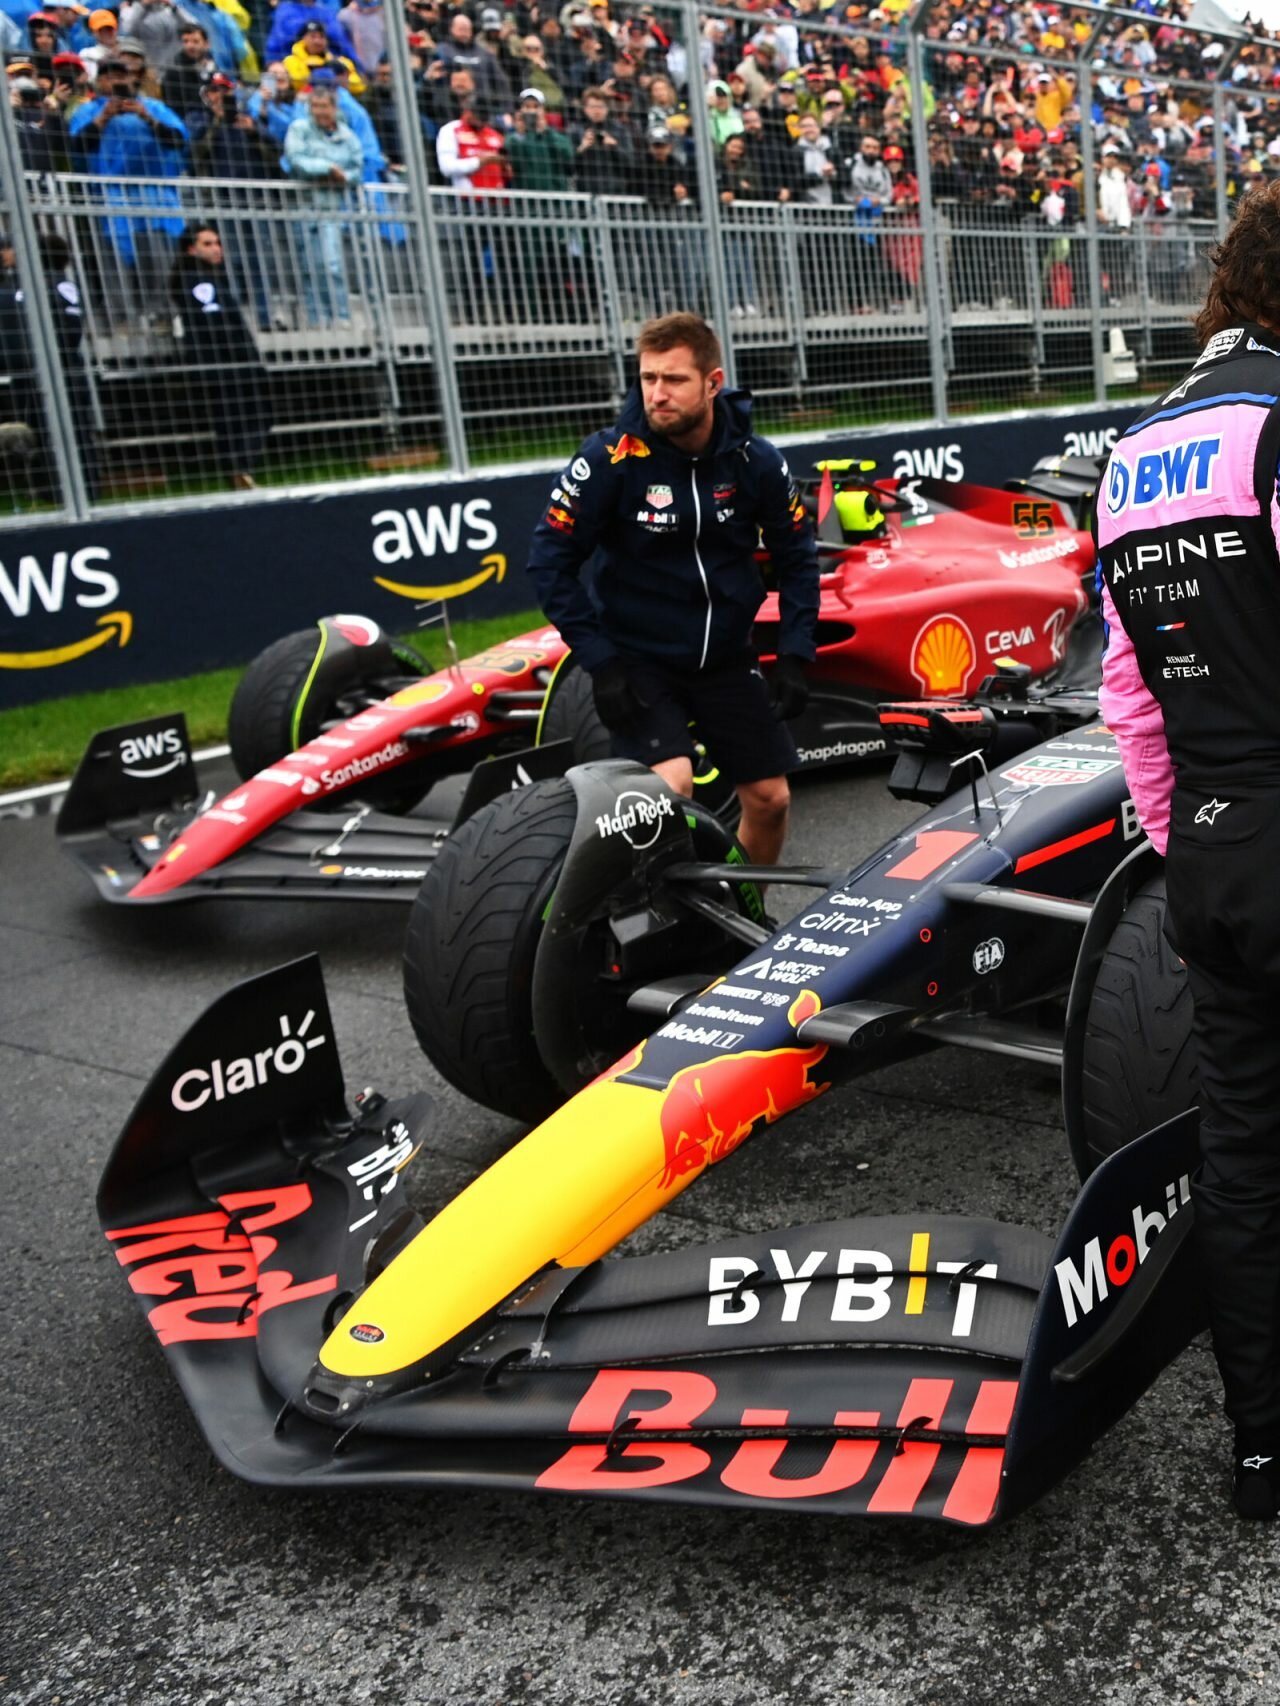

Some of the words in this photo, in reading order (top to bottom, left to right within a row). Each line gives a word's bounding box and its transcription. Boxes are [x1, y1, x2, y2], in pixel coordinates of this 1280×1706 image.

[893, 444, 964, 482] aws
[1133, 438, 1220, 505] BWT
[371, 498, 498, 564] aws
[636, 511, 667, 524] Mobil
[1012, 501, 1055, 540] 55
[1112, 530, 1246, 585] ALPINE
[0, 546, 119, 617] ws
[1155, 579, 1200, 603] TEAM
[1162, 665, 1210, 679] E-TECH
[1165, 654, 1196, 664] RENAULT
[120, 728, 182, 765] aws
[797, 738, 886, 763] Snapdragon
[1046, 742, 1121, 753] ORAC
[321, 741, 409, 790] Santander
[1010, 767, 1092, 783] HEUER
[1037, 758, 1110, 771] TAG
[594, 806, 637, 839] Hard
[636, 793, 675, 827] Rock
[884, 830, 980, 881] 1
[829, 893, 869, 908] Cash
[867, 898, 903, 912] App
[800, 911, 882, 937] citrix
[794, 937, 850, 957] Tezos
[974, 942, 1003, 970] FIA
[768, 972, 811, 985] WOLF
[771, 960, 826, 977] ARCTIC
[657, 1022, 721, 1045] Mobil
[171, 1037, 306, 1112] Claro
[104, 1183, 338, 1347] Red
[1054, 1173, 1192, 1328] Mobil
[707, 1232, 997, 1337] BYBIT
[534, 1370, 1019, 1525] Bull
